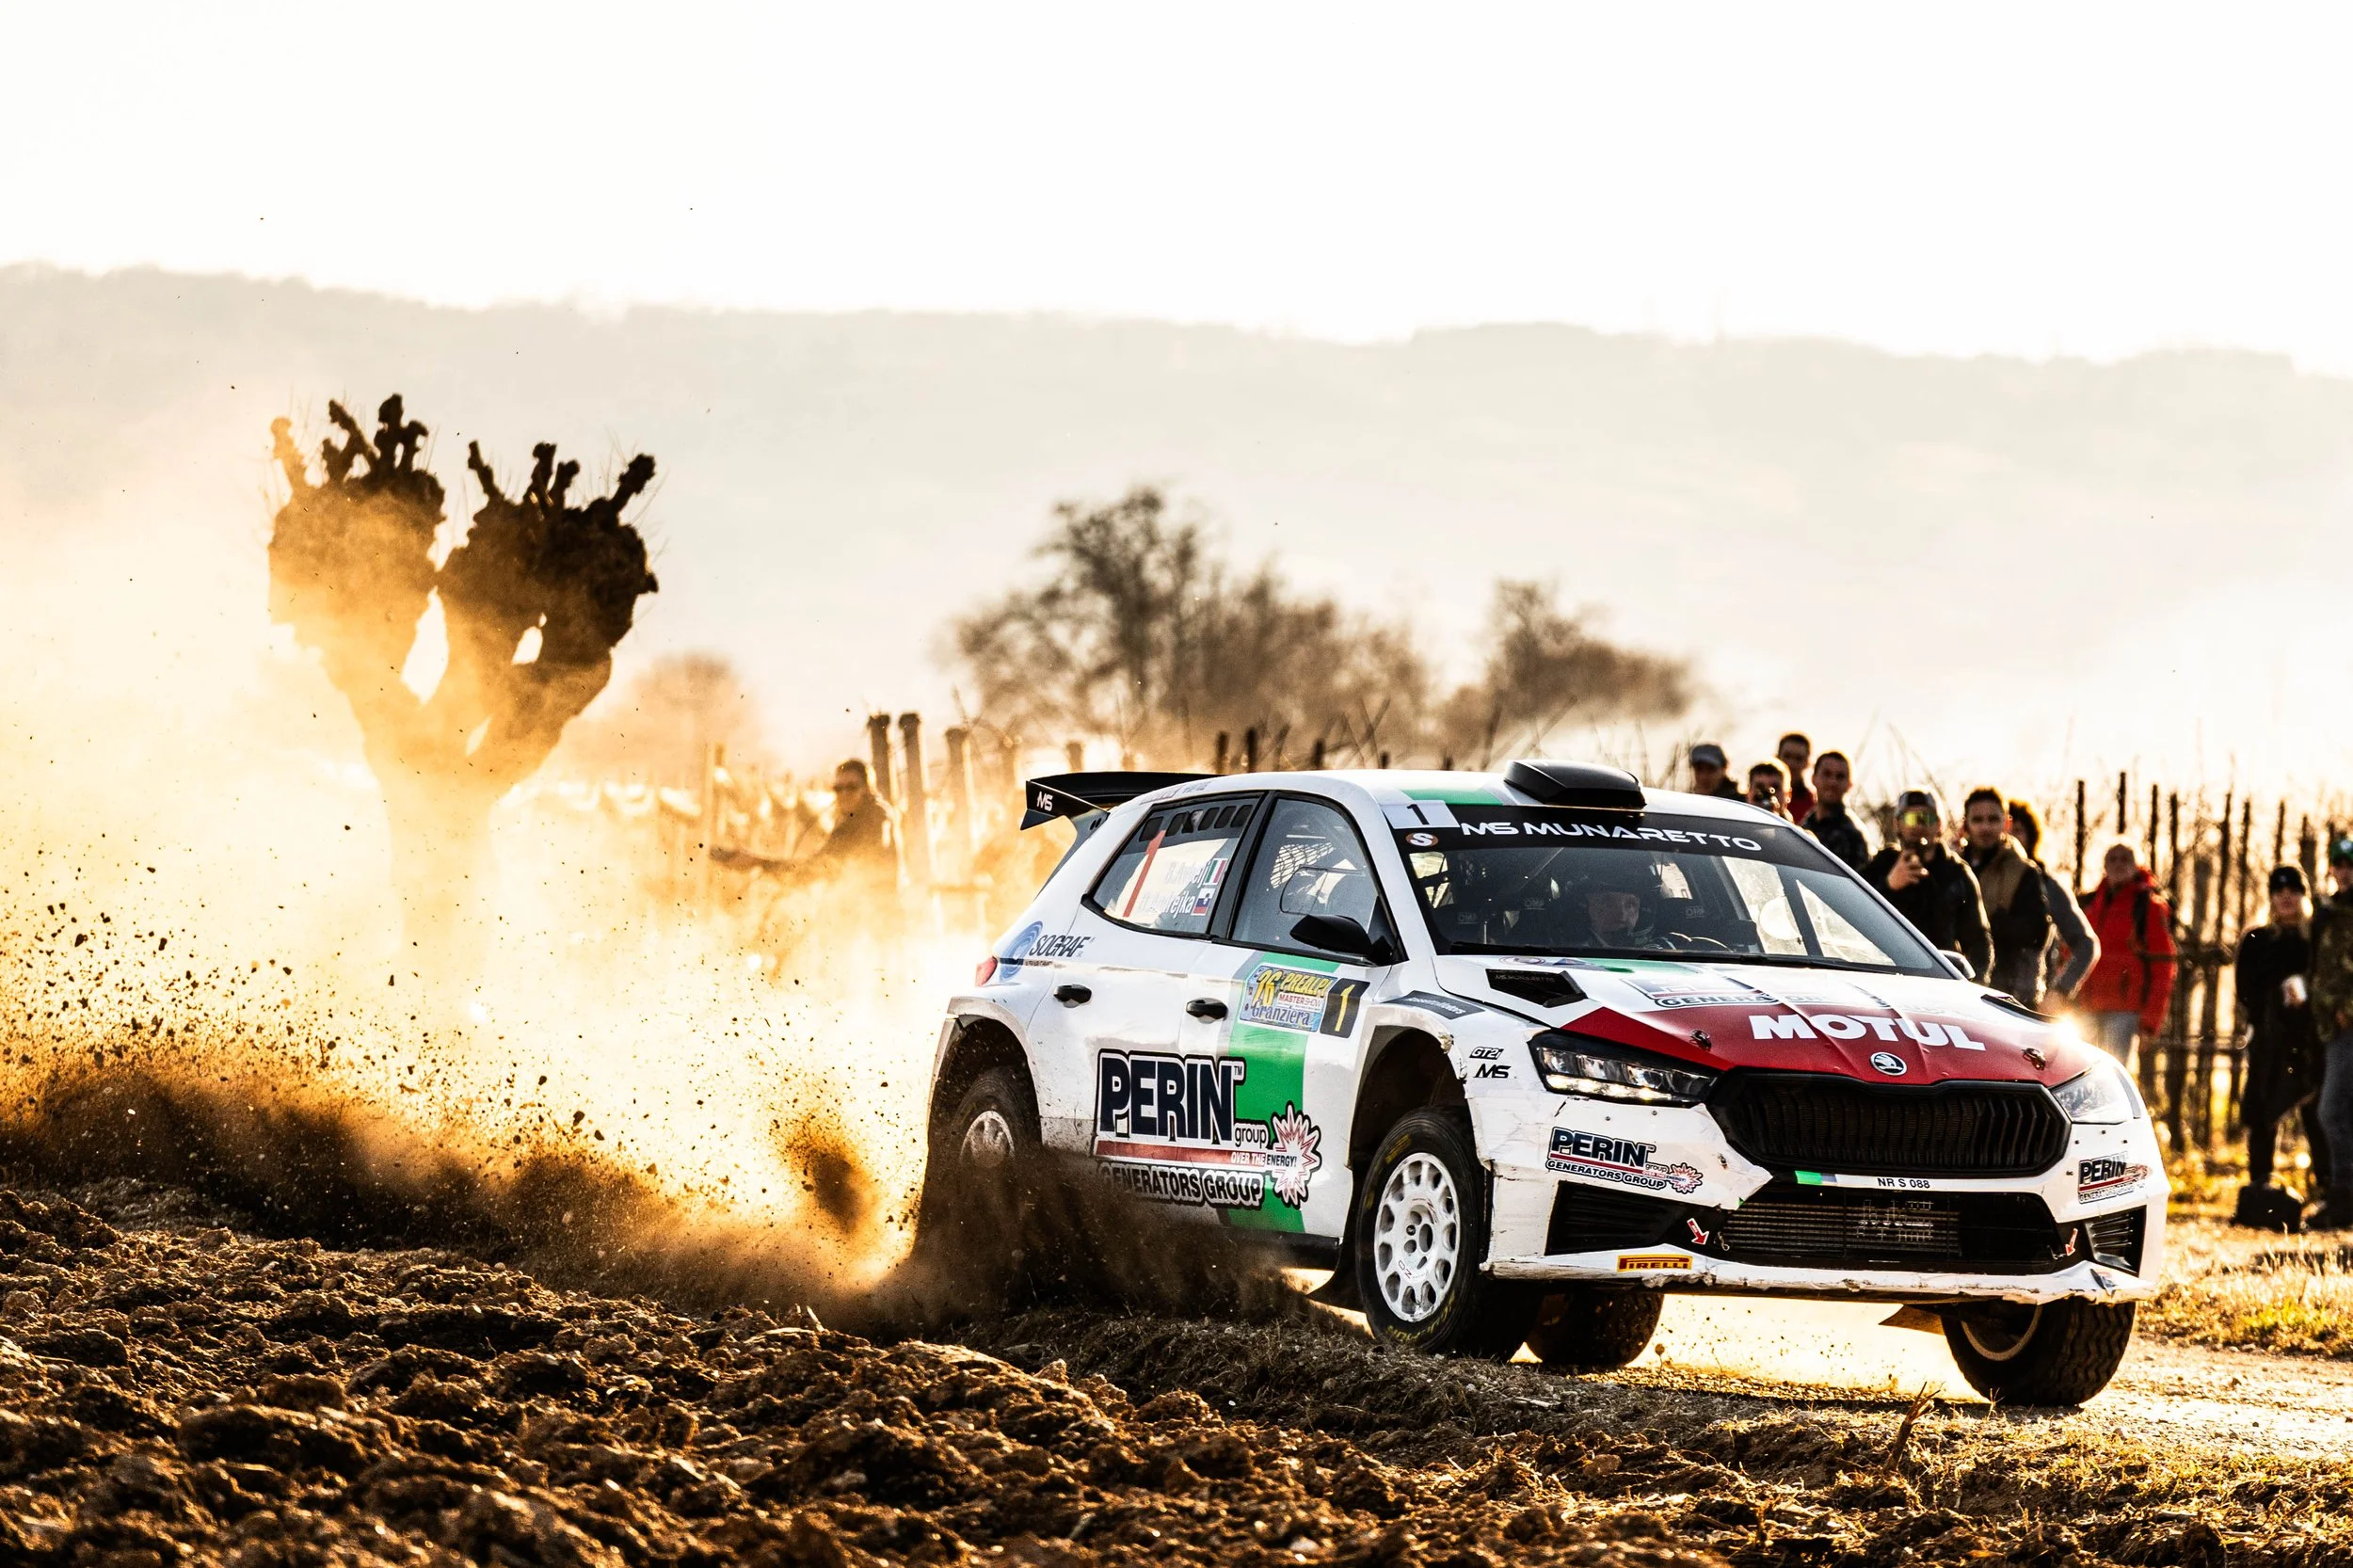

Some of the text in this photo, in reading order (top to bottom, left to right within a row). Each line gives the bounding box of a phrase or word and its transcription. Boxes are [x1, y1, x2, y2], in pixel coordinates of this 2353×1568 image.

[1037, 792, 1053, 812] MS
[1406, 803, 1430, 825] 1
[1461, 822, 1762, 852] MS MUNARETTO
[1029, 935, 1091, 957] SOGRAF
[1252, 968, 1333, 1007] 26 PREALPI
[1251, 1000, 1311, 1026] Granziera
[1334, 984, 1356, 1032] 1
[1749, 1014, 1987, 1051] MOTUL
[1473, 1064, 1512, 1078] MS
[1099, 1057, 1233, 1142] PERIN
[1235, 1126, 1268, 1147] group
[1552, 1129, 1647, 1168] PERIN
[1230, 1151, 1297, 1168] OVER THE ENERGY!
[1645, 1163, 1668, 1174] group
[2079, 1159, 2127, 1185] PERIN
[1097, 1163, 1262, 1205] GENERATORS GROUP
[1547, 1160, 1665, 1189] GENERATORS GROUP
[1877, 1177, 1930, 1189] NR S 088
[1619, 1256, 1690, 1270] PIRELLI
